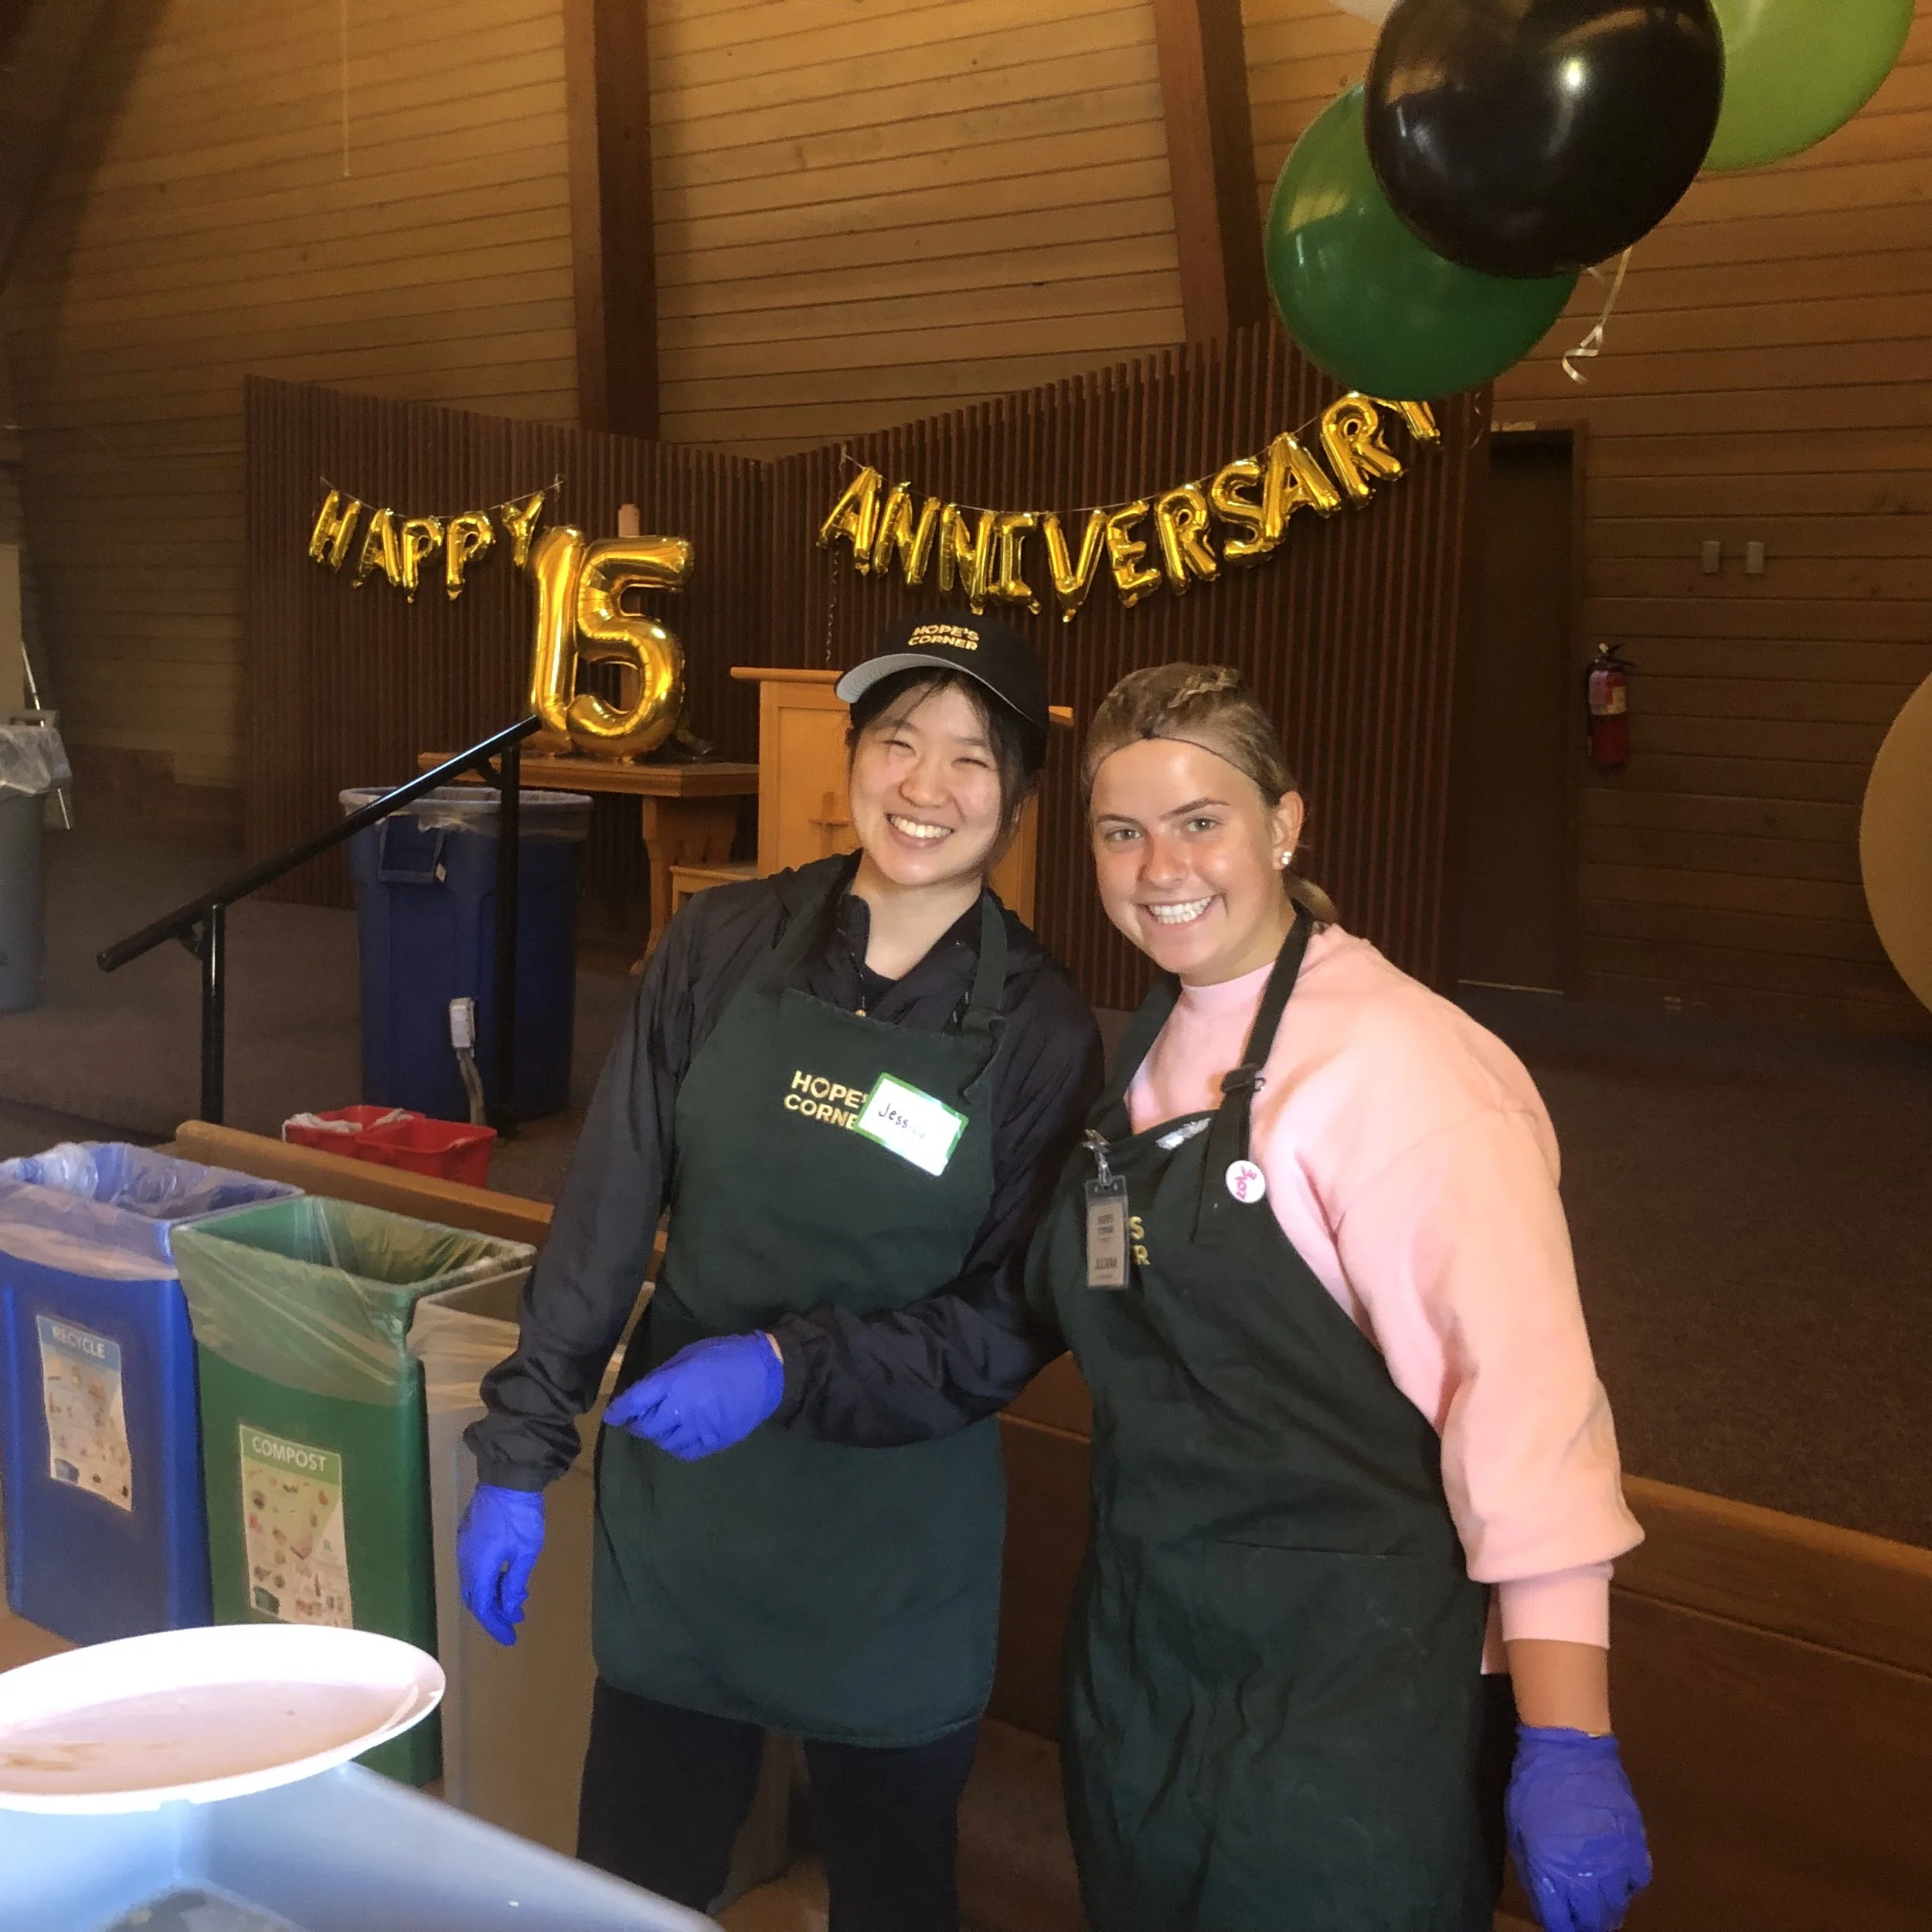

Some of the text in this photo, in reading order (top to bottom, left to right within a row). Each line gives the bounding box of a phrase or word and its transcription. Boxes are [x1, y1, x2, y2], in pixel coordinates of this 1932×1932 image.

[309, 489, 544, 603] HAPPY
[522, 524, 694, 757] 15
[908, 635, 978, 651] CORNER
[912, 624, 980, 641] HOPE'S
[791, 1070, 869, 1109] HOPE'
[783, 1094, 859, 1131] CORNE
[52, 1325, 106, 1359] RECYCLE
[252, 1436, 328, 1472] COMPOST
